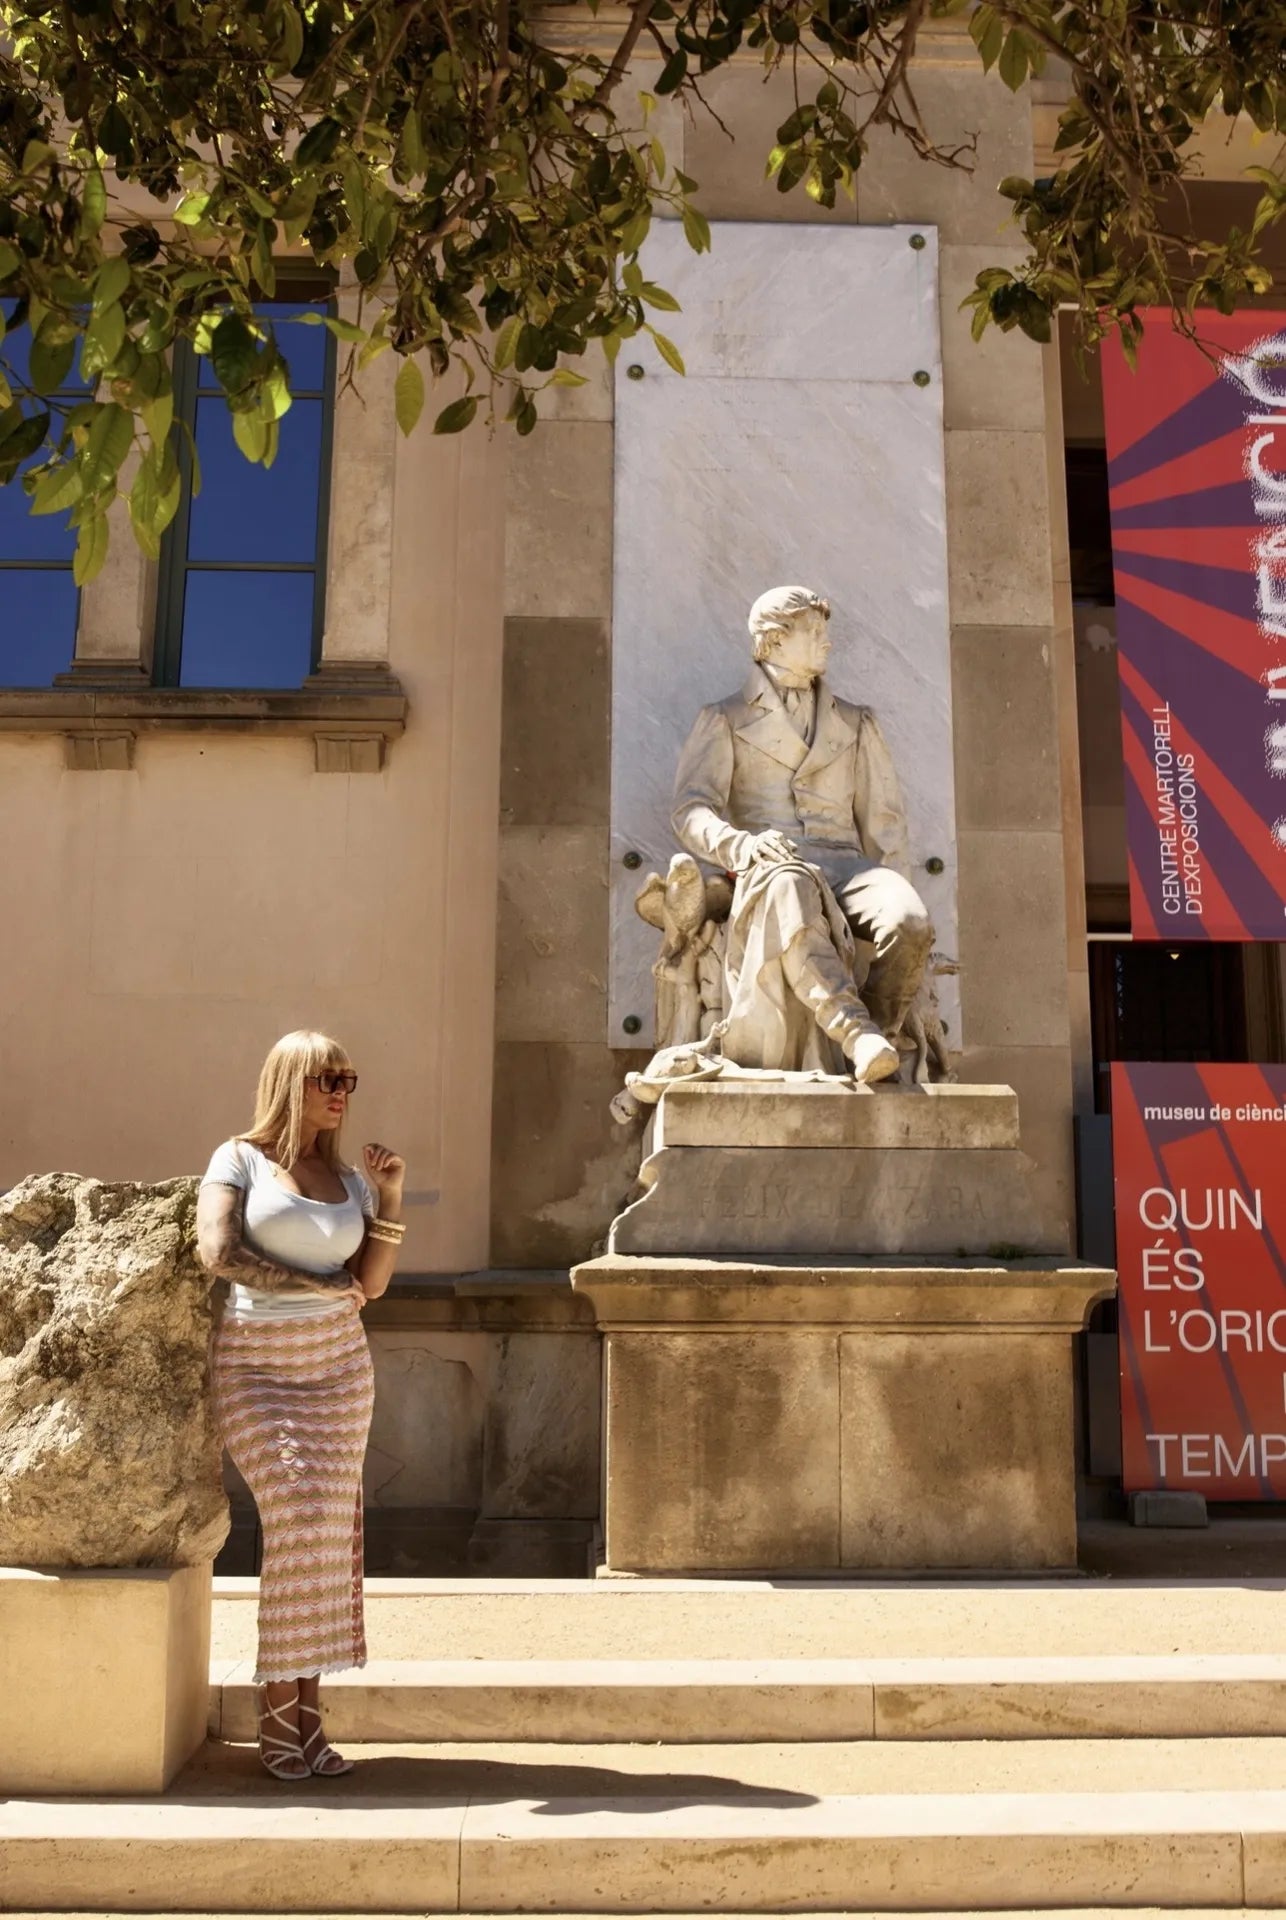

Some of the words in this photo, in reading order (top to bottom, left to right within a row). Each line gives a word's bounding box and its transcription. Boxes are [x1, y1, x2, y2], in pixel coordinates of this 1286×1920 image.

[1152, 701, 1176, 826] MARTORELL
[1178, 753, 1203, 915] D'EXPOSICIONS
[1160, 829, 1180, 915] CENTRE
[1144, 1106, 1205, 1121] museu
[1209, 1103, 1231, 1121] de
[1139, 1187, 1263, 1233] QUIN
[1141, 1238, 1205, 1292] ÉS
[1145, 1434, 1286, 1477] TEMP
